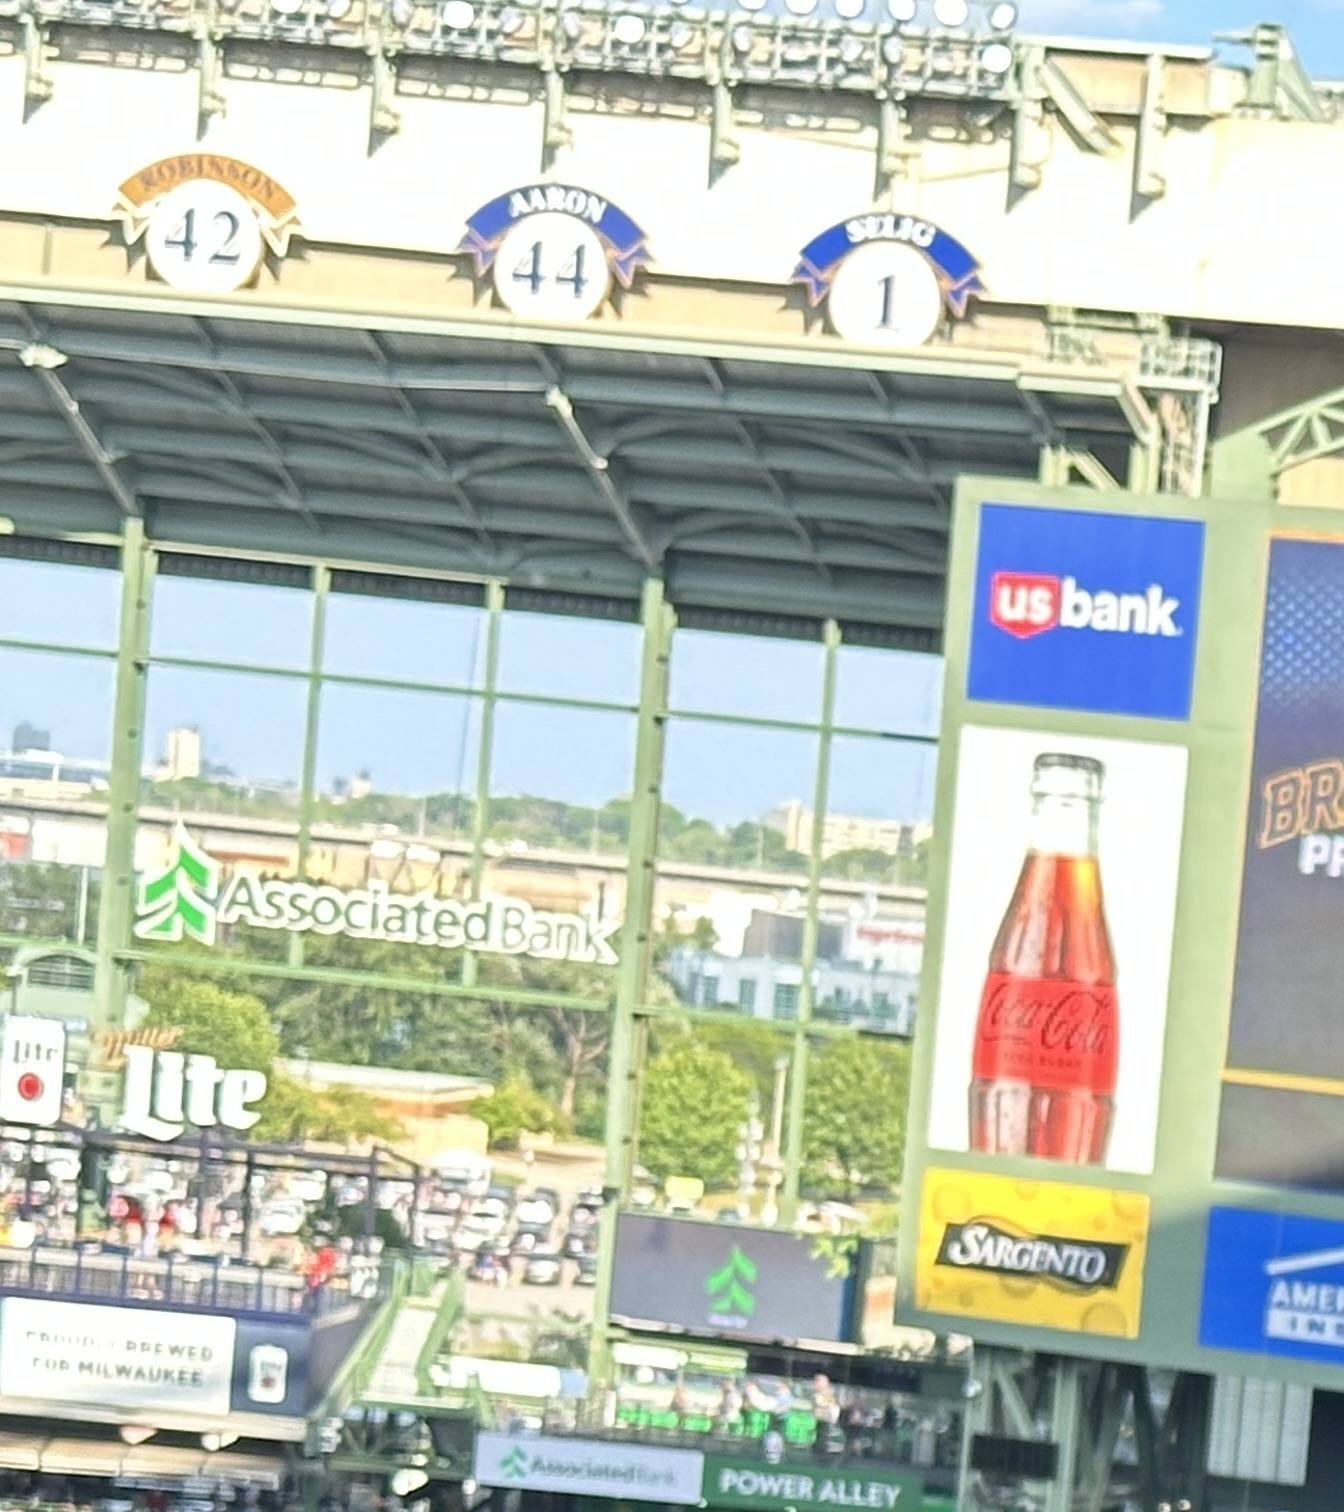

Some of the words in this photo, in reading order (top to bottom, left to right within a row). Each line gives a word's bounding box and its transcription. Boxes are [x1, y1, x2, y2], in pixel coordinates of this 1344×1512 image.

[508, 186, 608, 224] AARON
[164, 208, 241, 265] 42
[512, 241, 589, 299] 44
[875, 274, 900, 331] 1
[998, 584, 1053, 624] us
[1060, 575, 1180, 636] bank
[220, 870, 494, 948] Associated
[498, 898, 621, 966] Bank
[983, 983, 1111, 1054] Coca-Cola
[118, 1044, 267, 1142] Lite
[947, 1225, 1107, 1283] SARGENTO
[78, 1360, 205, 1386] MILWAUKEE
[719, 1466, 814, 1501] POWER
[818, 1479, 902, 1508] ALLEY
